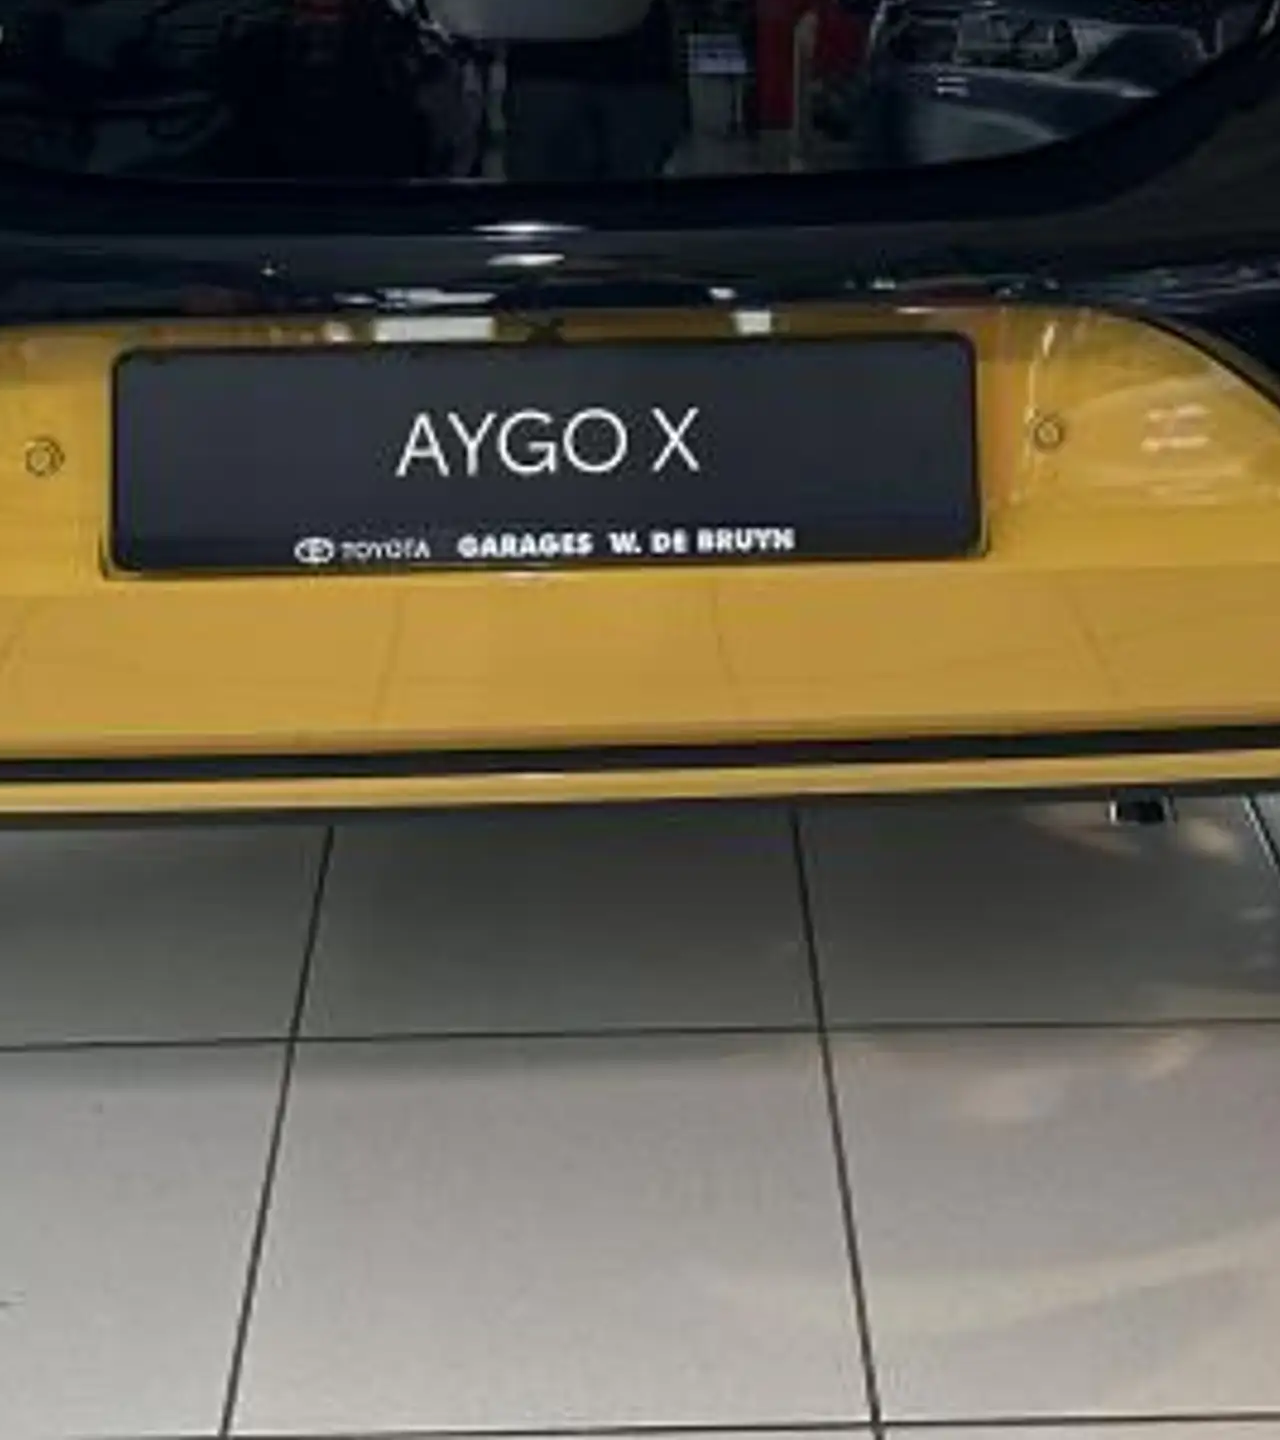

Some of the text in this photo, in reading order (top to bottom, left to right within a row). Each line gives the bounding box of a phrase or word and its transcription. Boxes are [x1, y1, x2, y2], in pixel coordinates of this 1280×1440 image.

[395, 407, 700, 477] AYGO X
[339, 526, 796, 561] TOYOTA GARAGES W. DE BRUYN
